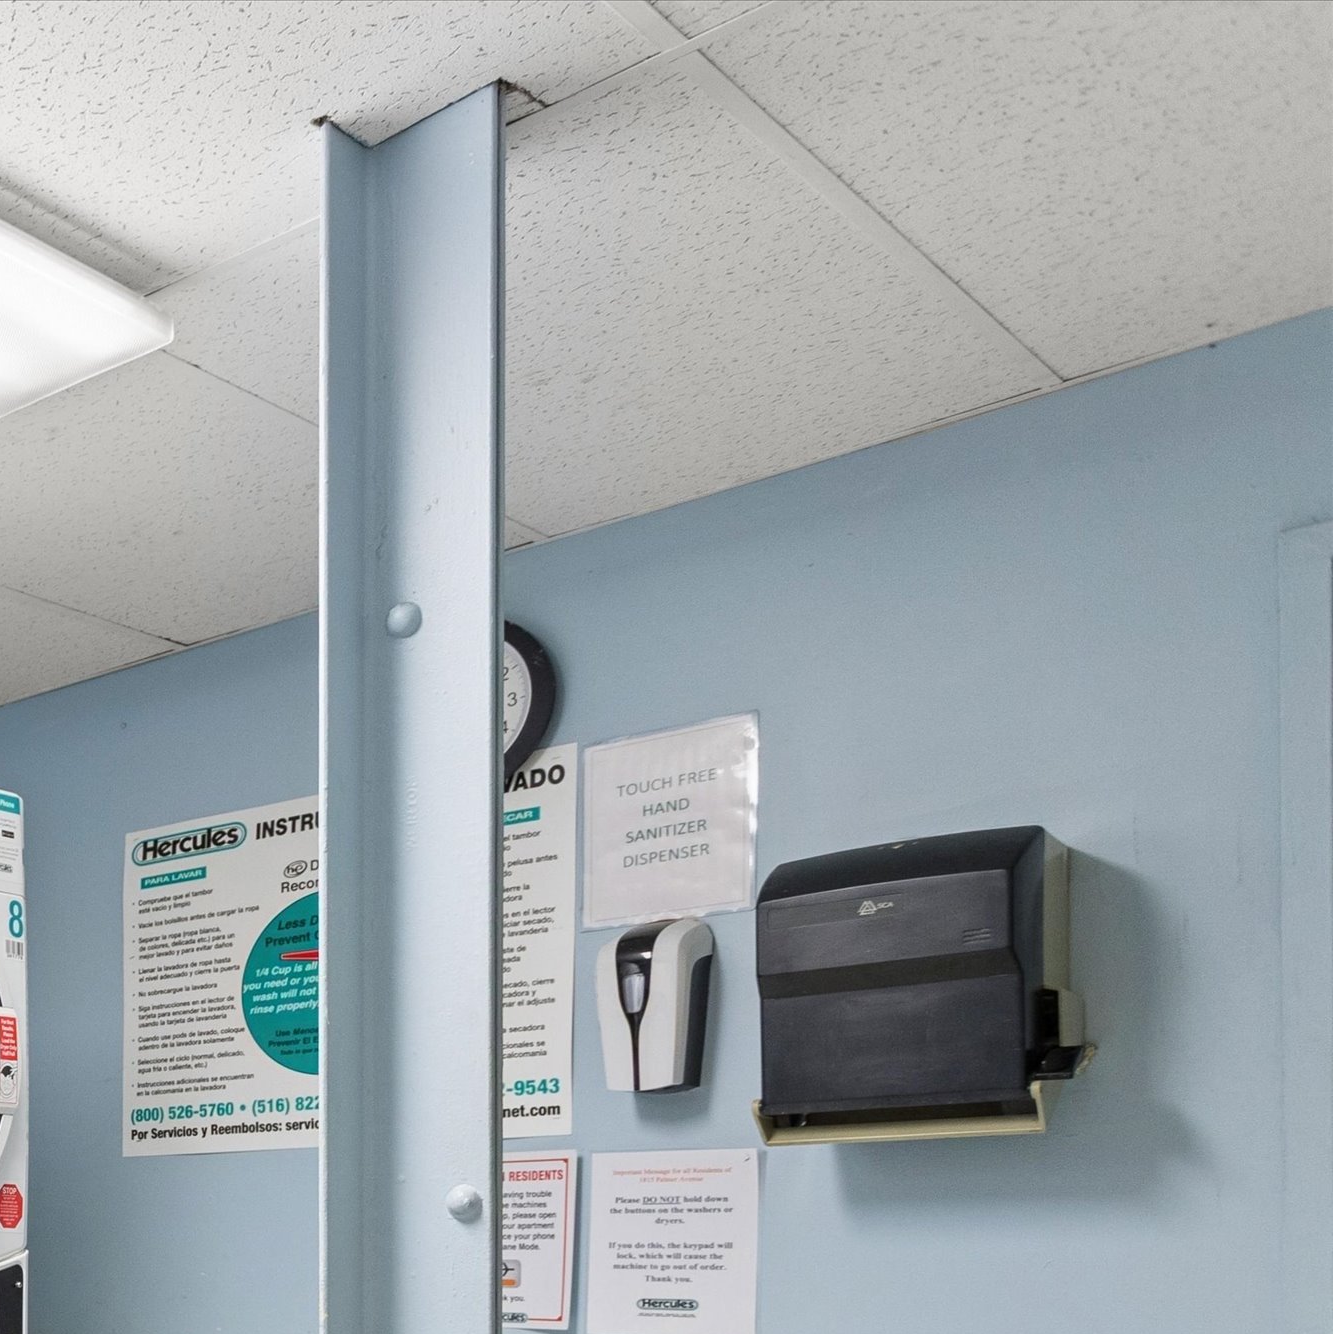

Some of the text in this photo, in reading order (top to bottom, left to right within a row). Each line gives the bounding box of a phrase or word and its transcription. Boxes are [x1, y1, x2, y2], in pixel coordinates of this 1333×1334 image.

[507, 692, 518, 707] 3
[617, 767, 717, 798] TOUCH FREE
[642, 798, 691, 817] HAND
[625, 818, 708, 844] SANITIZER
[142, 827, 239, 861] Hercules
[623, 843, 710, 869] DISPENSER
[144, 869, 202, 887] PARA LAVAR
[876, 901, 894, 909] SCA
[9, 900, 24, 938] 8
[277, 917, 306, 931] Less
[265, 933, 306, 948] Prevent
[255, 961, 318, 977] 1/4 Cup is all
[243, 977, 301, 993] you need or
[252, 987, 317, 1002] wash will not
[249, 1004, 275, 1015] rinse
[130, 1097, 290, 1126] (800) 526-5760 (516)
[131, 1121, 283, 1142] Por Servicios y Reembolsos:
[508, 1169, 564, 1182] RESIDENTS
[615, 1196, 640, 1204] Please
[642, 1196, 658, 1204] DO
[659, 1196, 681, 1204] NOT
[671, 1206, 683, 1214] the
[686, 1206, 721, 1214] washers
[655, 1217, 685, 1225] dryers.
[641, 1299, 694, 1309] Hercules
